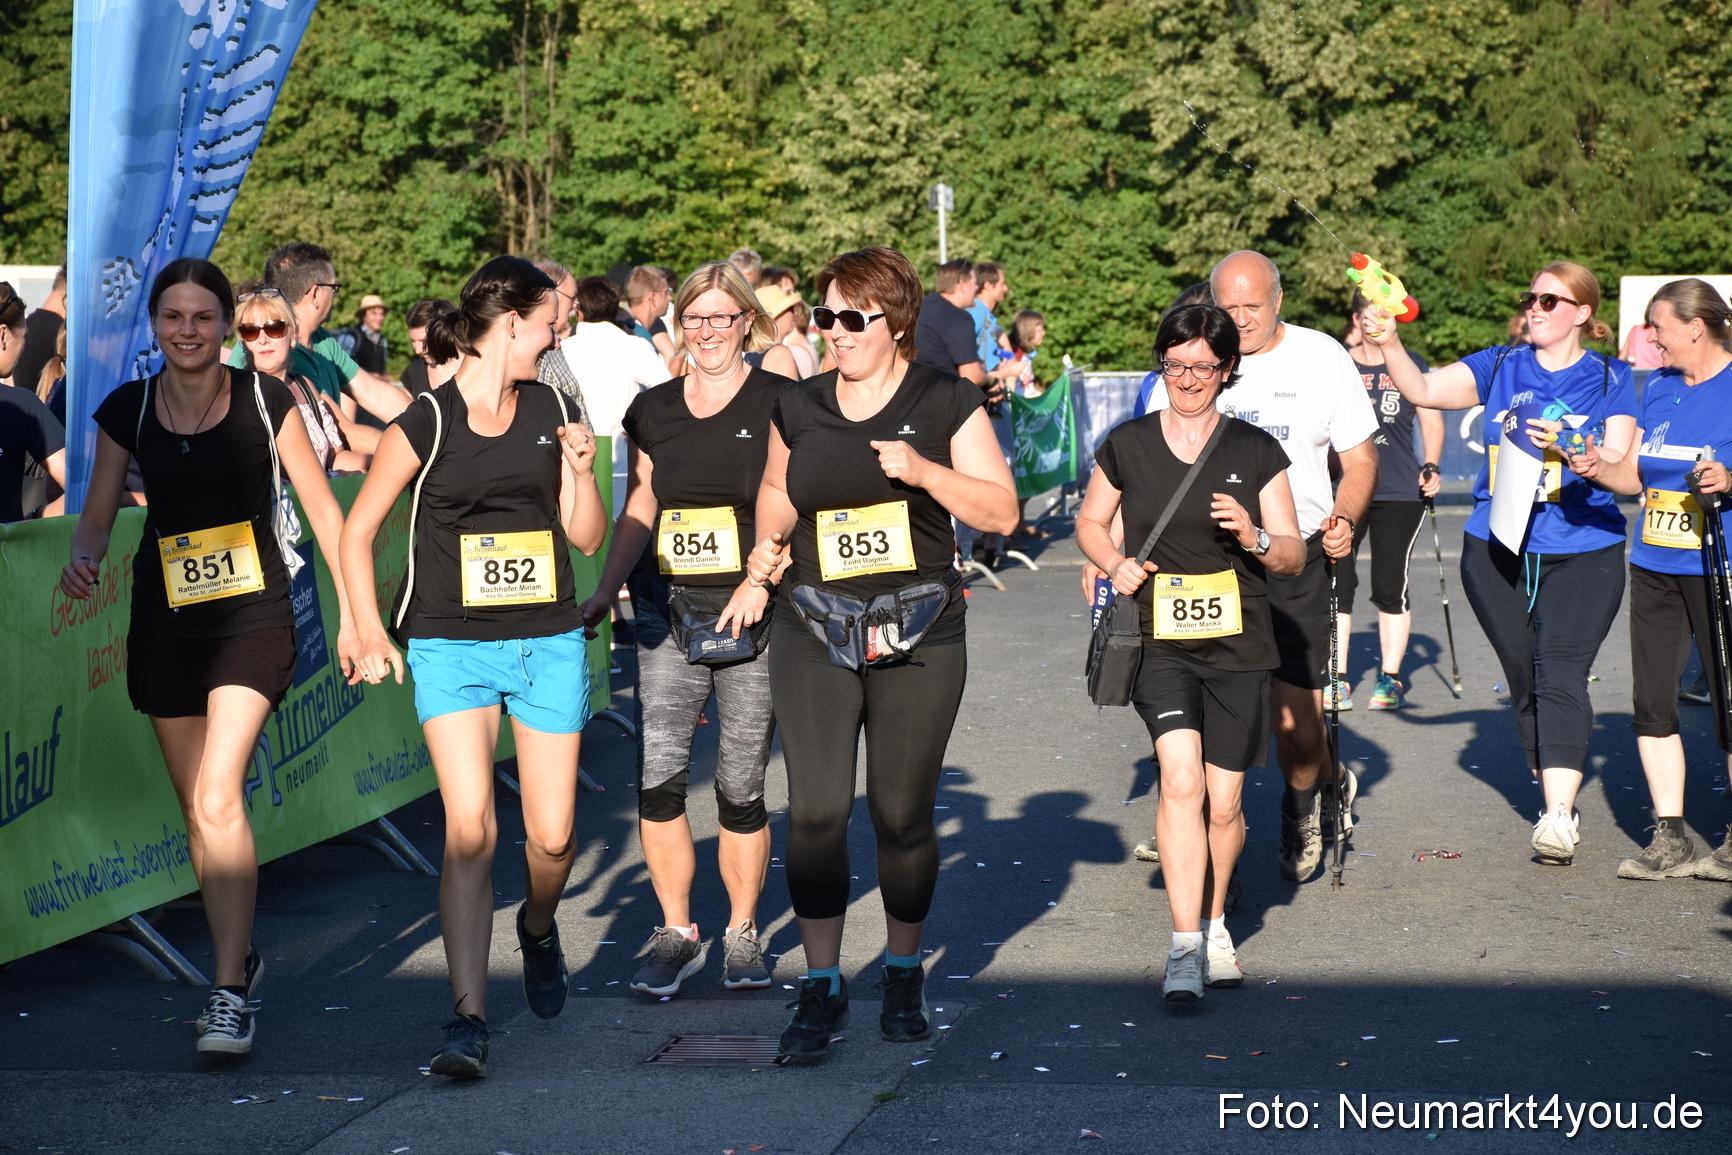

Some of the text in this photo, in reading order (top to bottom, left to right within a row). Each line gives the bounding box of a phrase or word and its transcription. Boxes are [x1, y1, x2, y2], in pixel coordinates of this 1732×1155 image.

[1274, 391, 1296, 399] Robert
[1380, 391, 1400, 416] 5
[1238, 410, 1259, 423] NIG
[1503, 416, 1517, 434] ER
[1648, 509, 1692, 532] 1778
[673, 531, 718, 556] 854
[838, 530, 889, 559] 853
[183, 551, 235, 584] 851
[695, 555, 720, 563] Daniela
[862, 556, 889, 565] Dagmar
[484, 558, 536, 585] 852
[178, 574, 251, 594] Rattelmüller Melanie
[223, 583, 241, 591] Deining
[480, 586, 517, 594] Bachhofer
[291, 587, 312, 615] ischer
[1097, 586, 1108, 606] OB
[1173, 597, 1222, 621] 855
[0, 705, 62, 818] lauf
[286, 740, 329, 793] neumarkt
